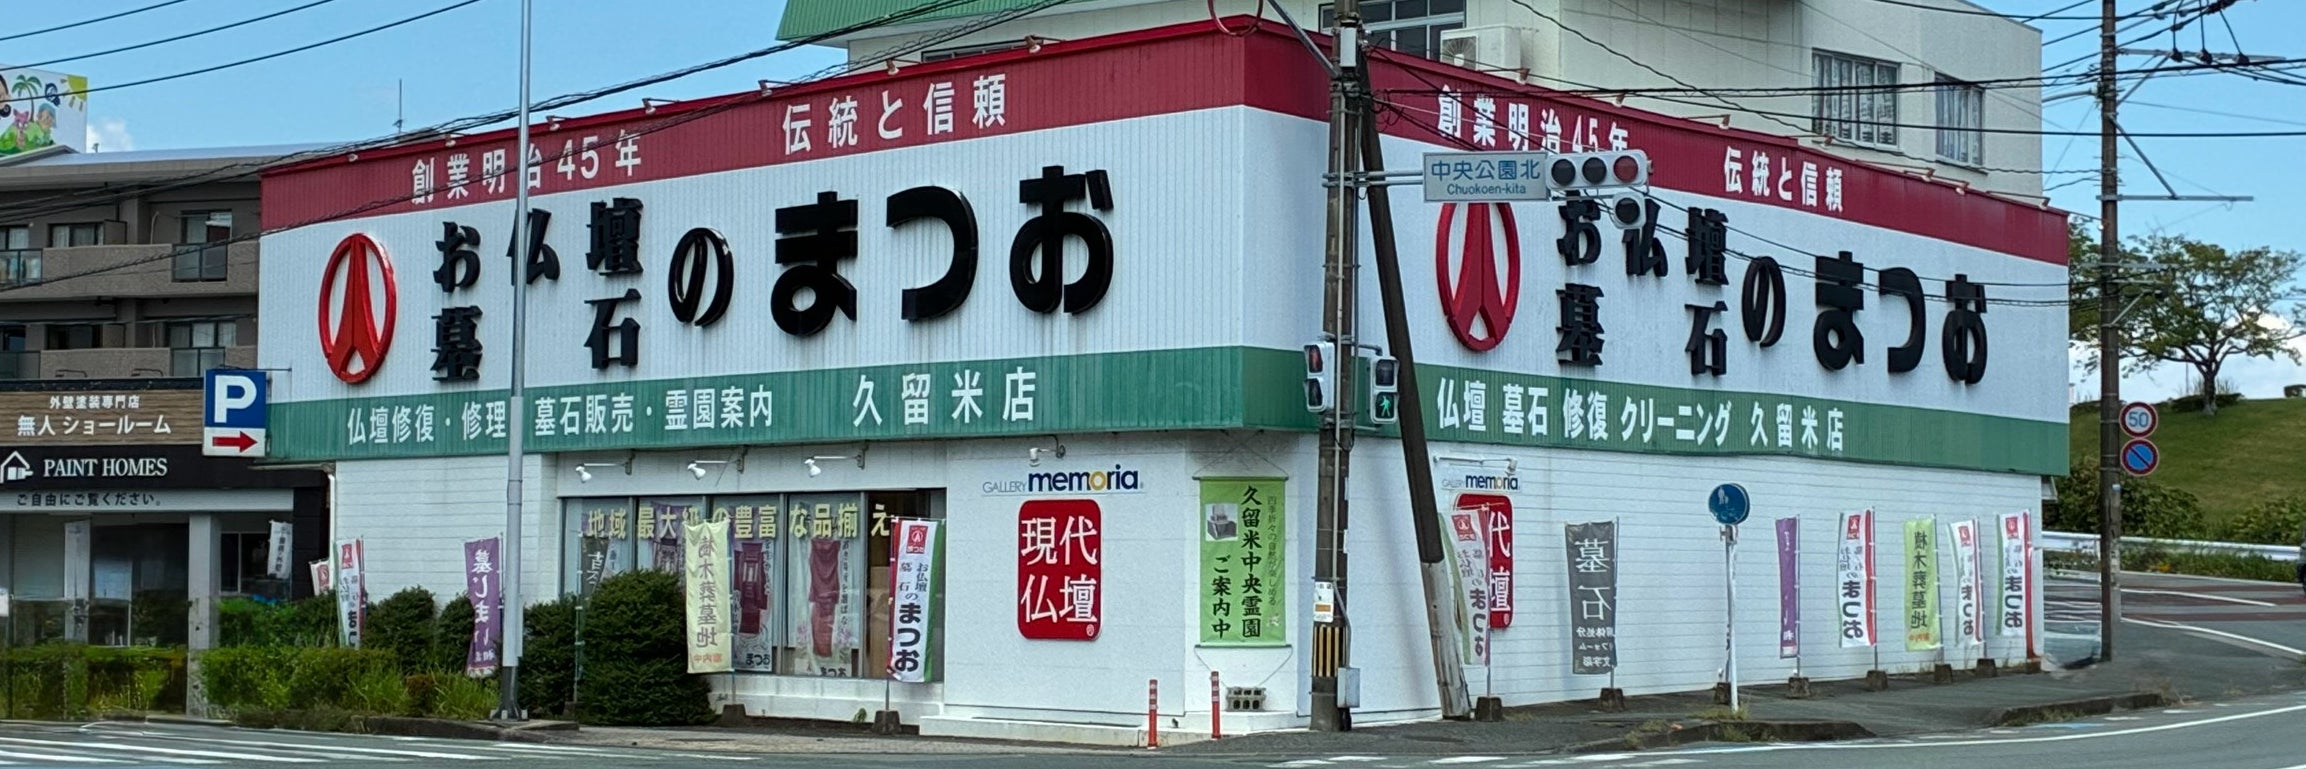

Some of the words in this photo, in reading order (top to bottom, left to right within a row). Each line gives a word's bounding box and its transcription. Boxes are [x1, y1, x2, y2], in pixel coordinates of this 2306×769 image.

[782, 73, 1006, 155] 伝統と信頼
[1431, 159, 1540, 181] 中央公園北
[1447, 183, 1527, 195] Chuokoen-kita
[1724, 146, 1843, 212] 伝統と信頼
[213, 374, 257, 424] P
[853, 366, 1036, 428] 久留米店
[1437, 376, 1486, 432] 仏壇
[1502, 383, 1548, 436] 墓石
[1563, 388, 1608, 440] 修復
[1620, 395, 1732, 447] クリーニング
[1750, 400, 1844, 452] 久留米店
[2128, 411, 2149, 428] 50
[44, 459, 98, 477] PAINT
[102, 457, 168, 476] HOMES
[982, 481, 1027, 493] GALLERY
[1028, 464, 1139, 492] memoria
[1465, 474, 1518, 490] memoria
[1021, 515, 1098, 566] 現代
[1240, 485, 1262, 638] 久留米中央霊園
[1021, 574, 1098, 623] 仏壇
[1211, 554, 1231, 639] ご案内中
